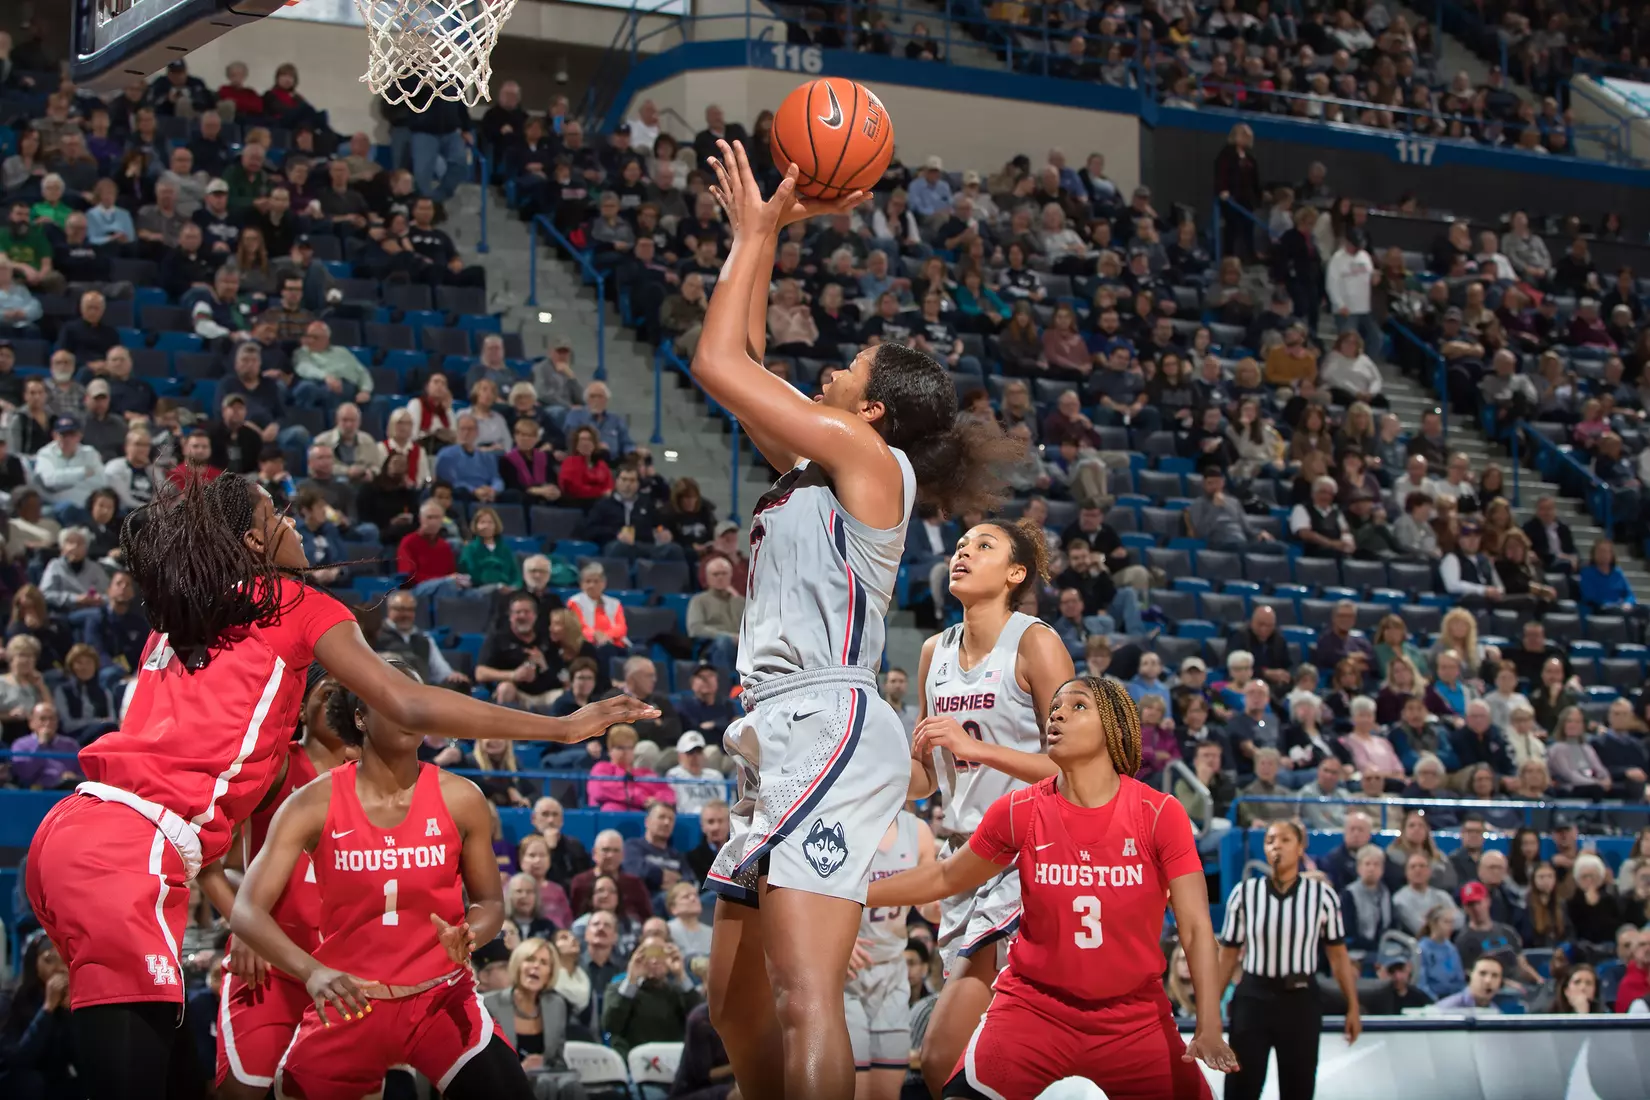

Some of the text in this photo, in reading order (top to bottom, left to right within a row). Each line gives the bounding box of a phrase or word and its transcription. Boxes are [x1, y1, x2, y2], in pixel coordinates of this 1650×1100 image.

[771, 45, 823, 73] 116
[862, 93, 883, 140] ELIT
[1395, 140, 1435, 165] 117
[934, 692, 996, 713] HUSKIES
[425, 818, 441, 836] A
[334, 844, 446, 871] HOUSTON
[1122, 838, 1138, 857] A
[1034, 863, 1143, 887] HOUSTON
[382, 879, 399, 926] 1
[1072, 895, 1103, 949] 3
